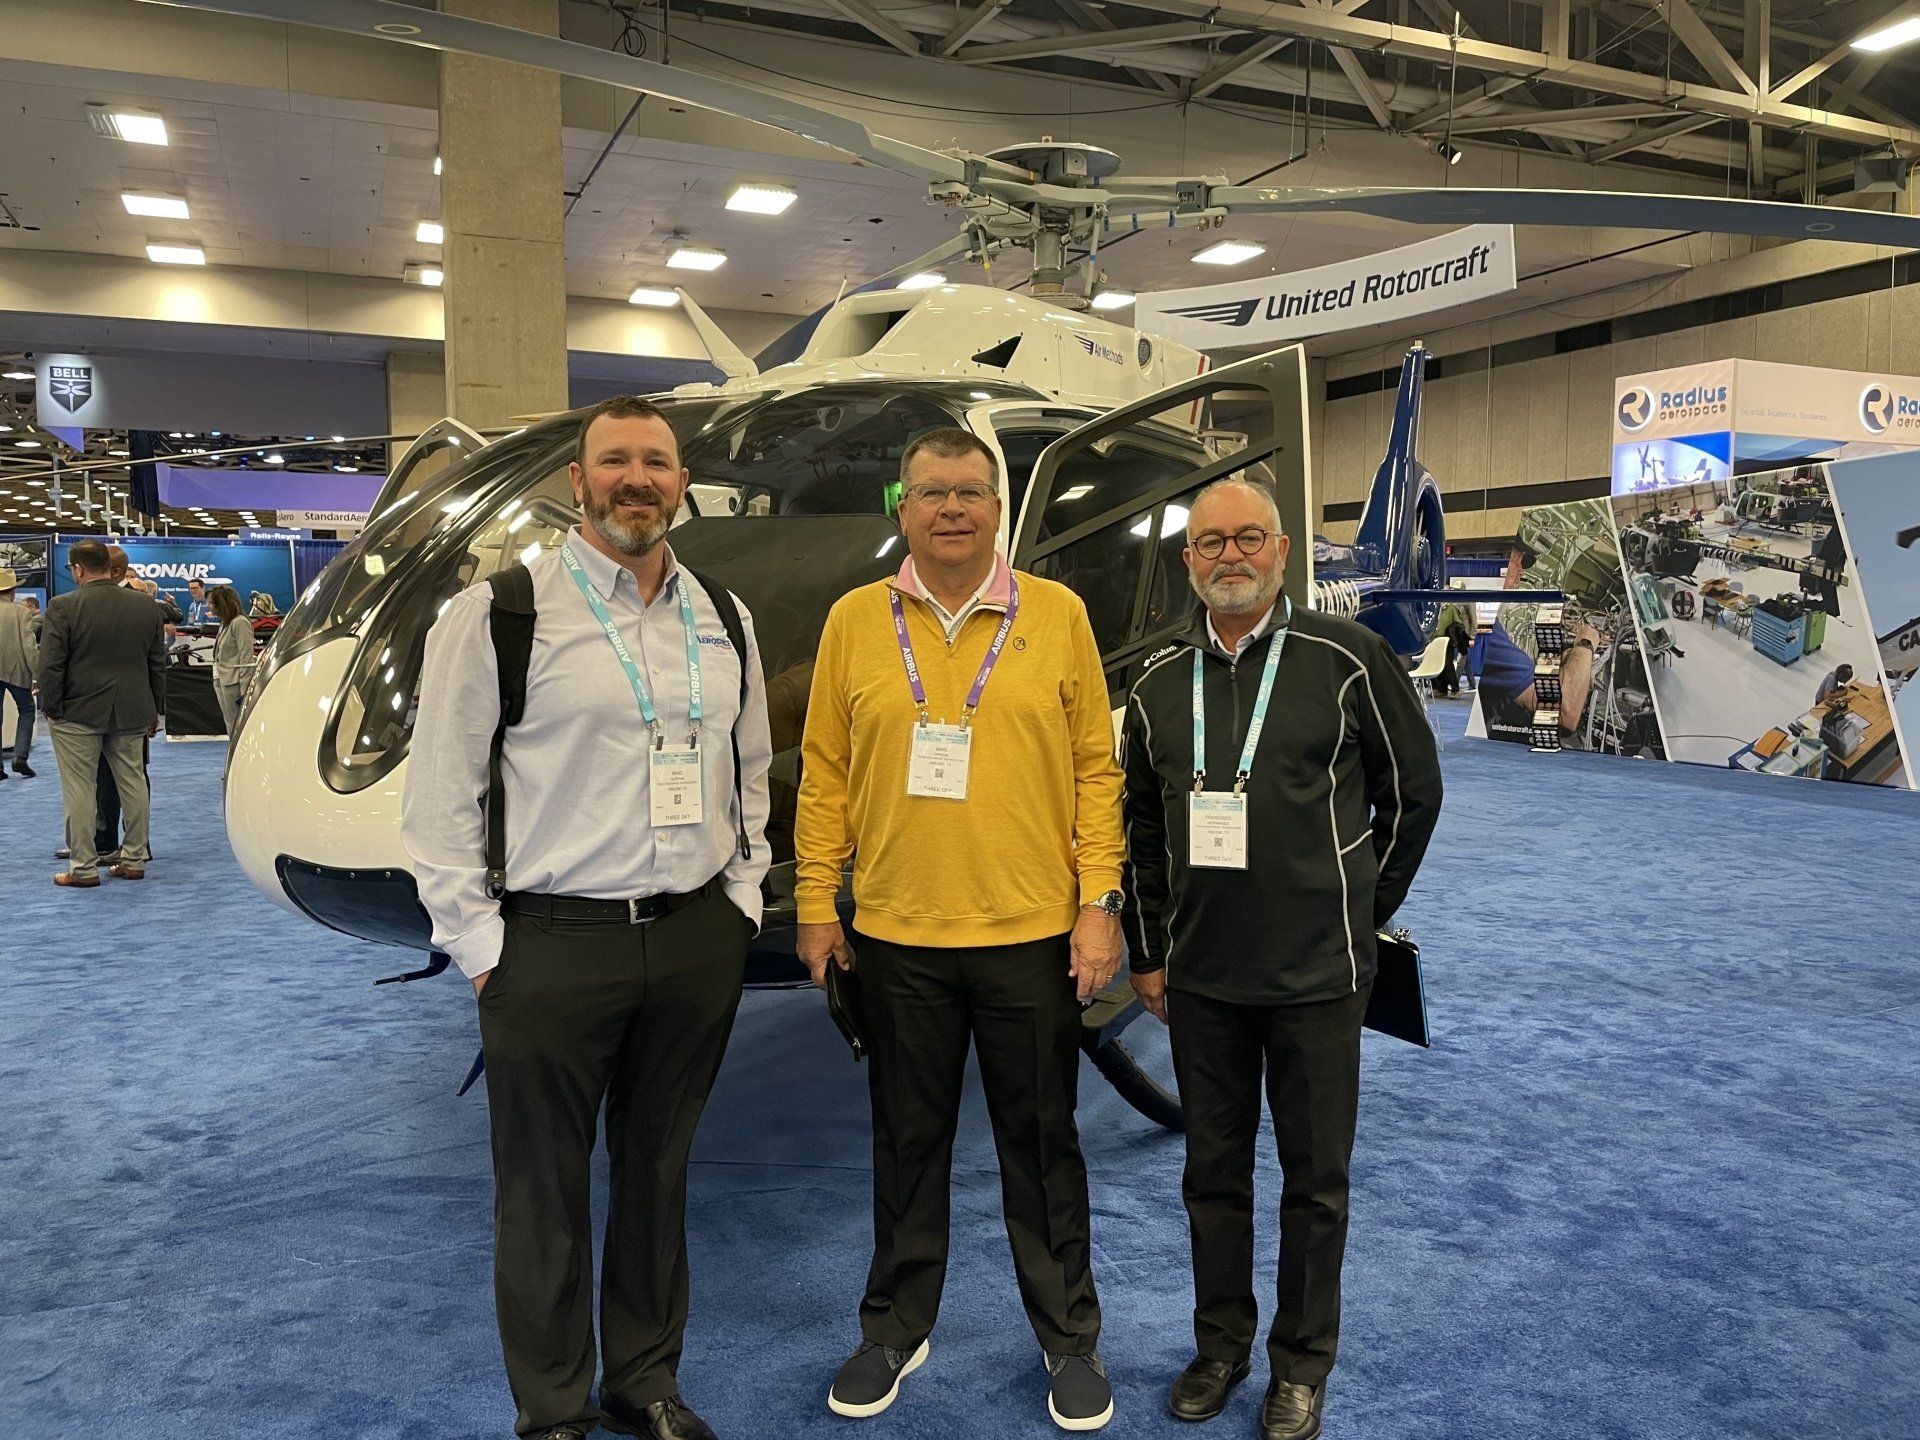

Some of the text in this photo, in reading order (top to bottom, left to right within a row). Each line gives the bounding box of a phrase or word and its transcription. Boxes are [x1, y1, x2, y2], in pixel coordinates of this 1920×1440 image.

[1265, 279, 1356, 320] United
[1094, 343, 1124, 366] Air Methods
[52, 367, 88, 379] BELL
[1660, 386, 1727, 410] Radius
[1660, 403, 1727, 421] aerospace
[1898, 396, 1920, 415] Ra
[250, 532, 301, 541] Rolls-Royce
[604, 621, 632, 663] AIRBUS
[991, 618, 1012, 656] AIRBUS
[689, 661, 701, 704] AIRBUS
[902, 647, 919, 683] AIRBUS
[1193, 683, 1203, 720] AIRBUS
[1244, 717, 1263, 756] AIRBUS
